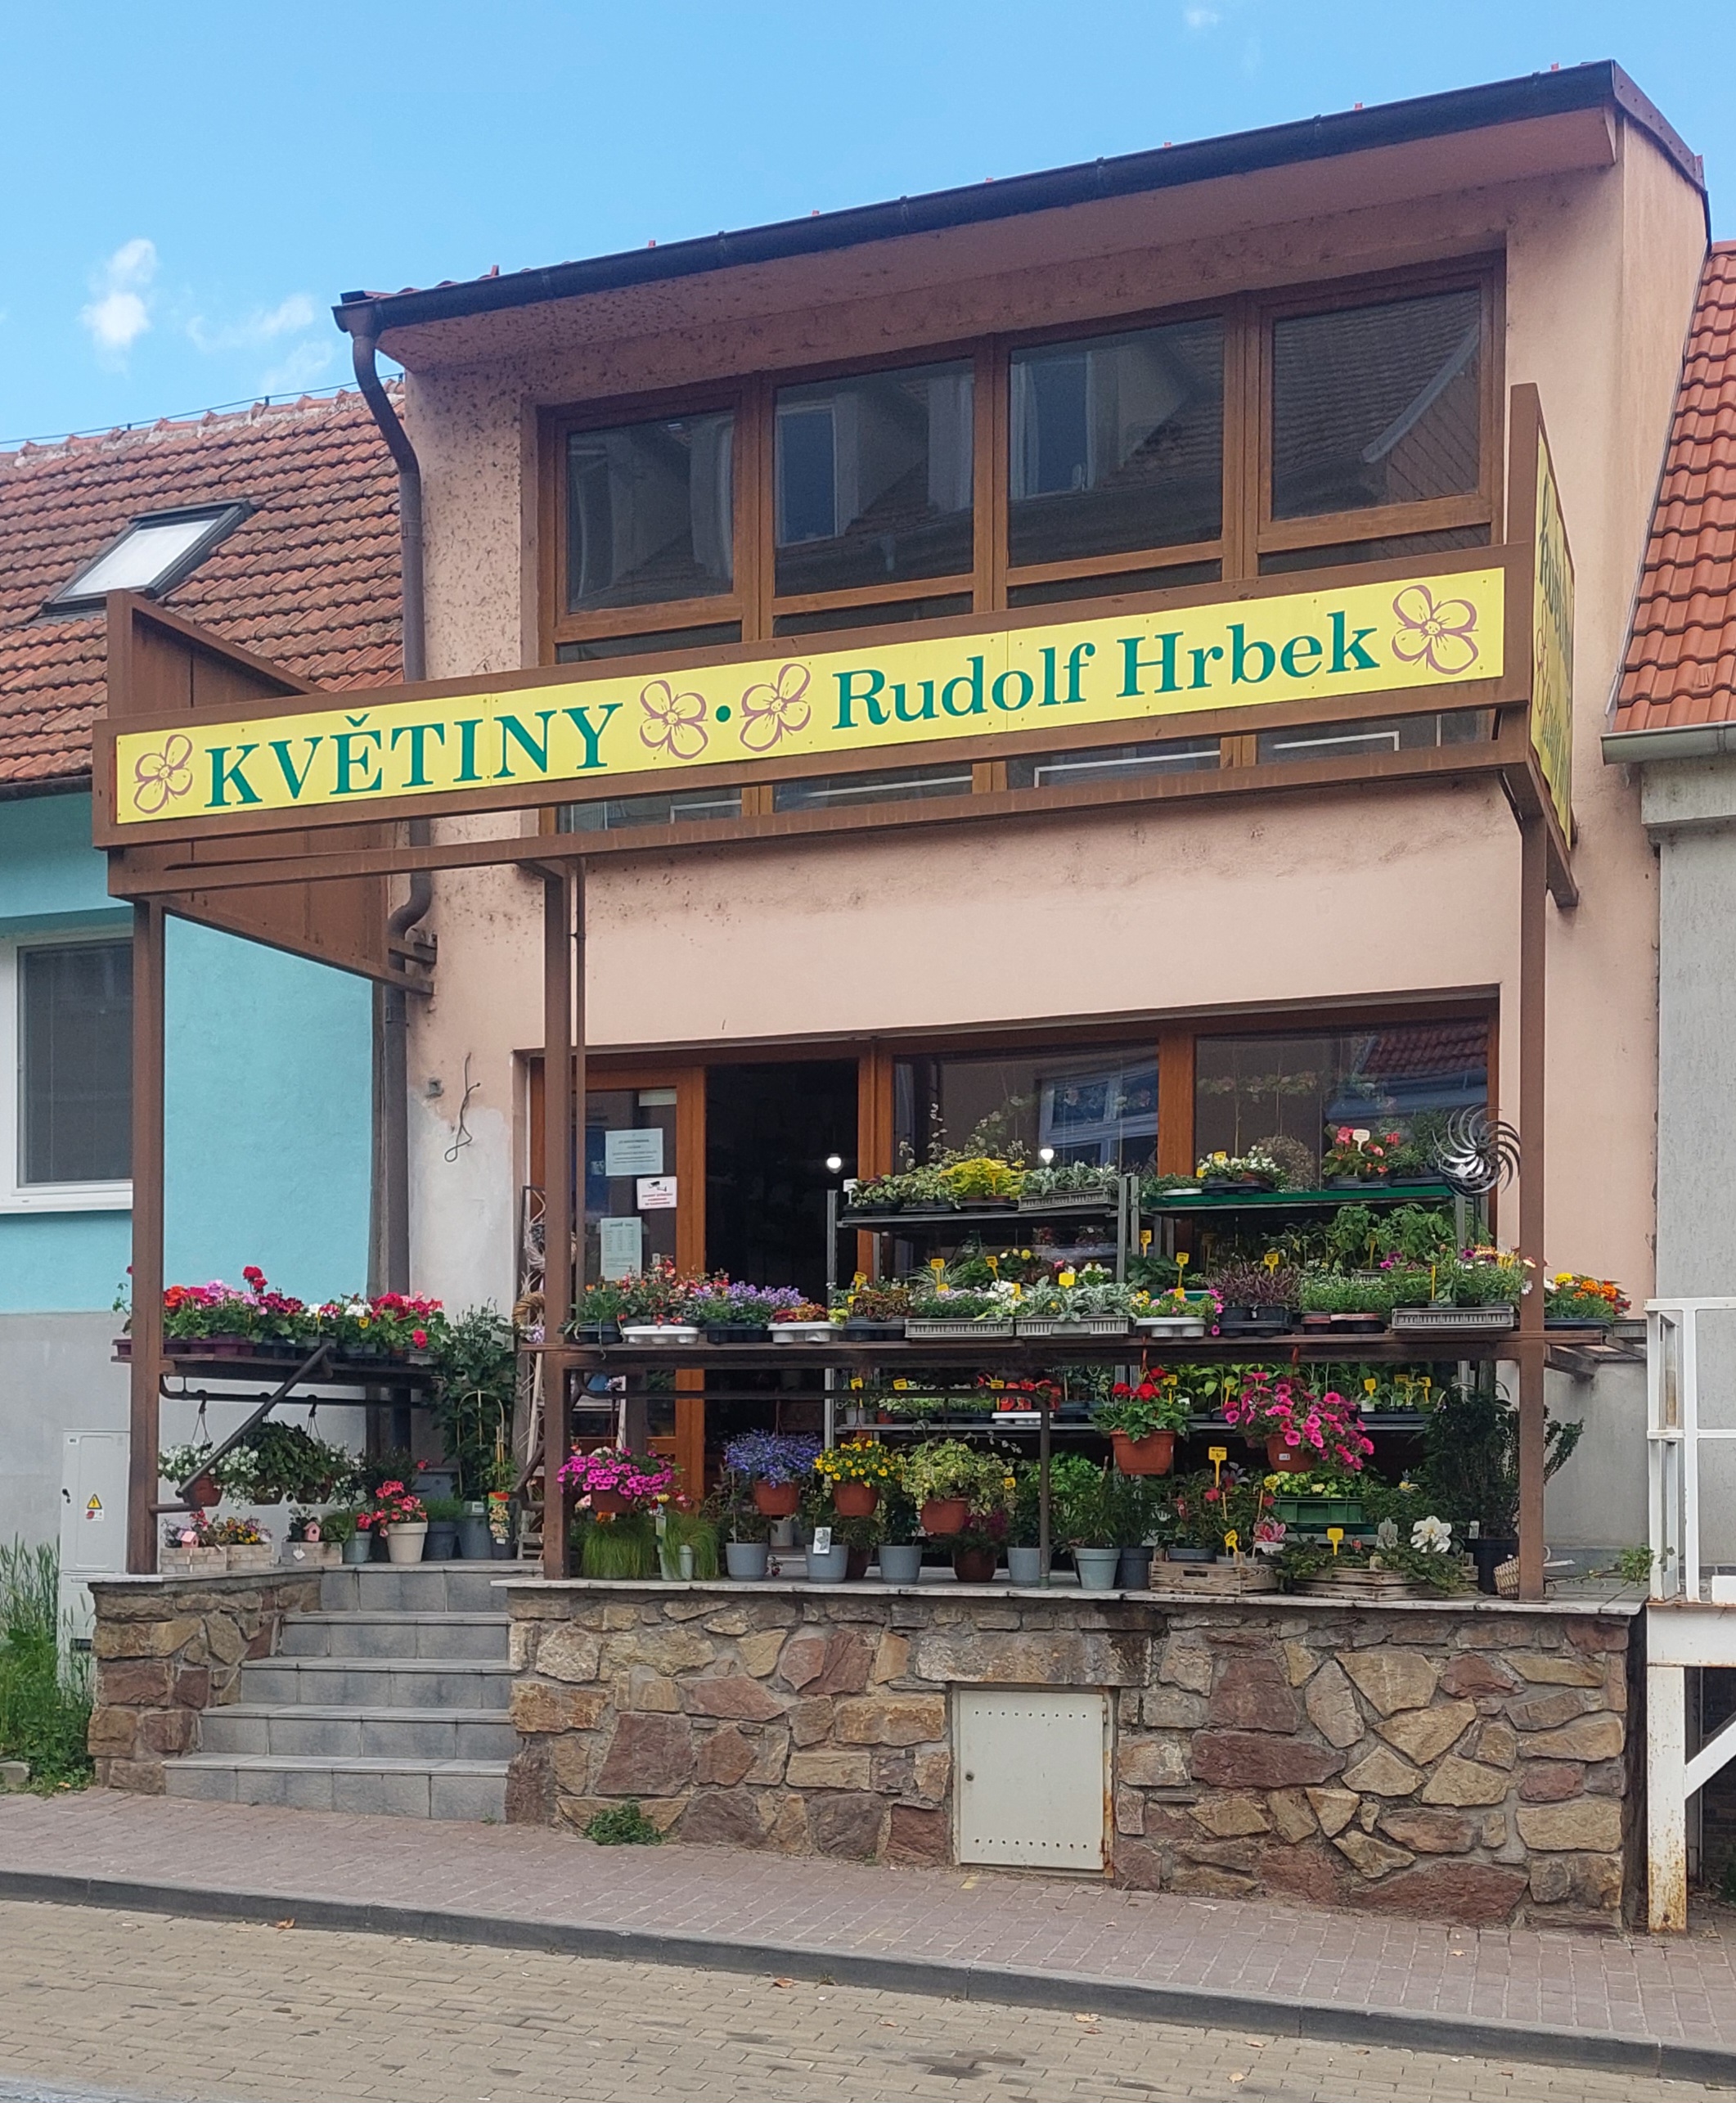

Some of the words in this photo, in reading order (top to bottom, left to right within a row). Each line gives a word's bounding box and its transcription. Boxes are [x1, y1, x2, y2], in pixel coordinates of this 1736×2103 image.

[205, 703, 623, 808] KVĚTINY
[832, 642, 1096, 730] Rudolf
[1116, 610, 1381, 698] Hrbek
